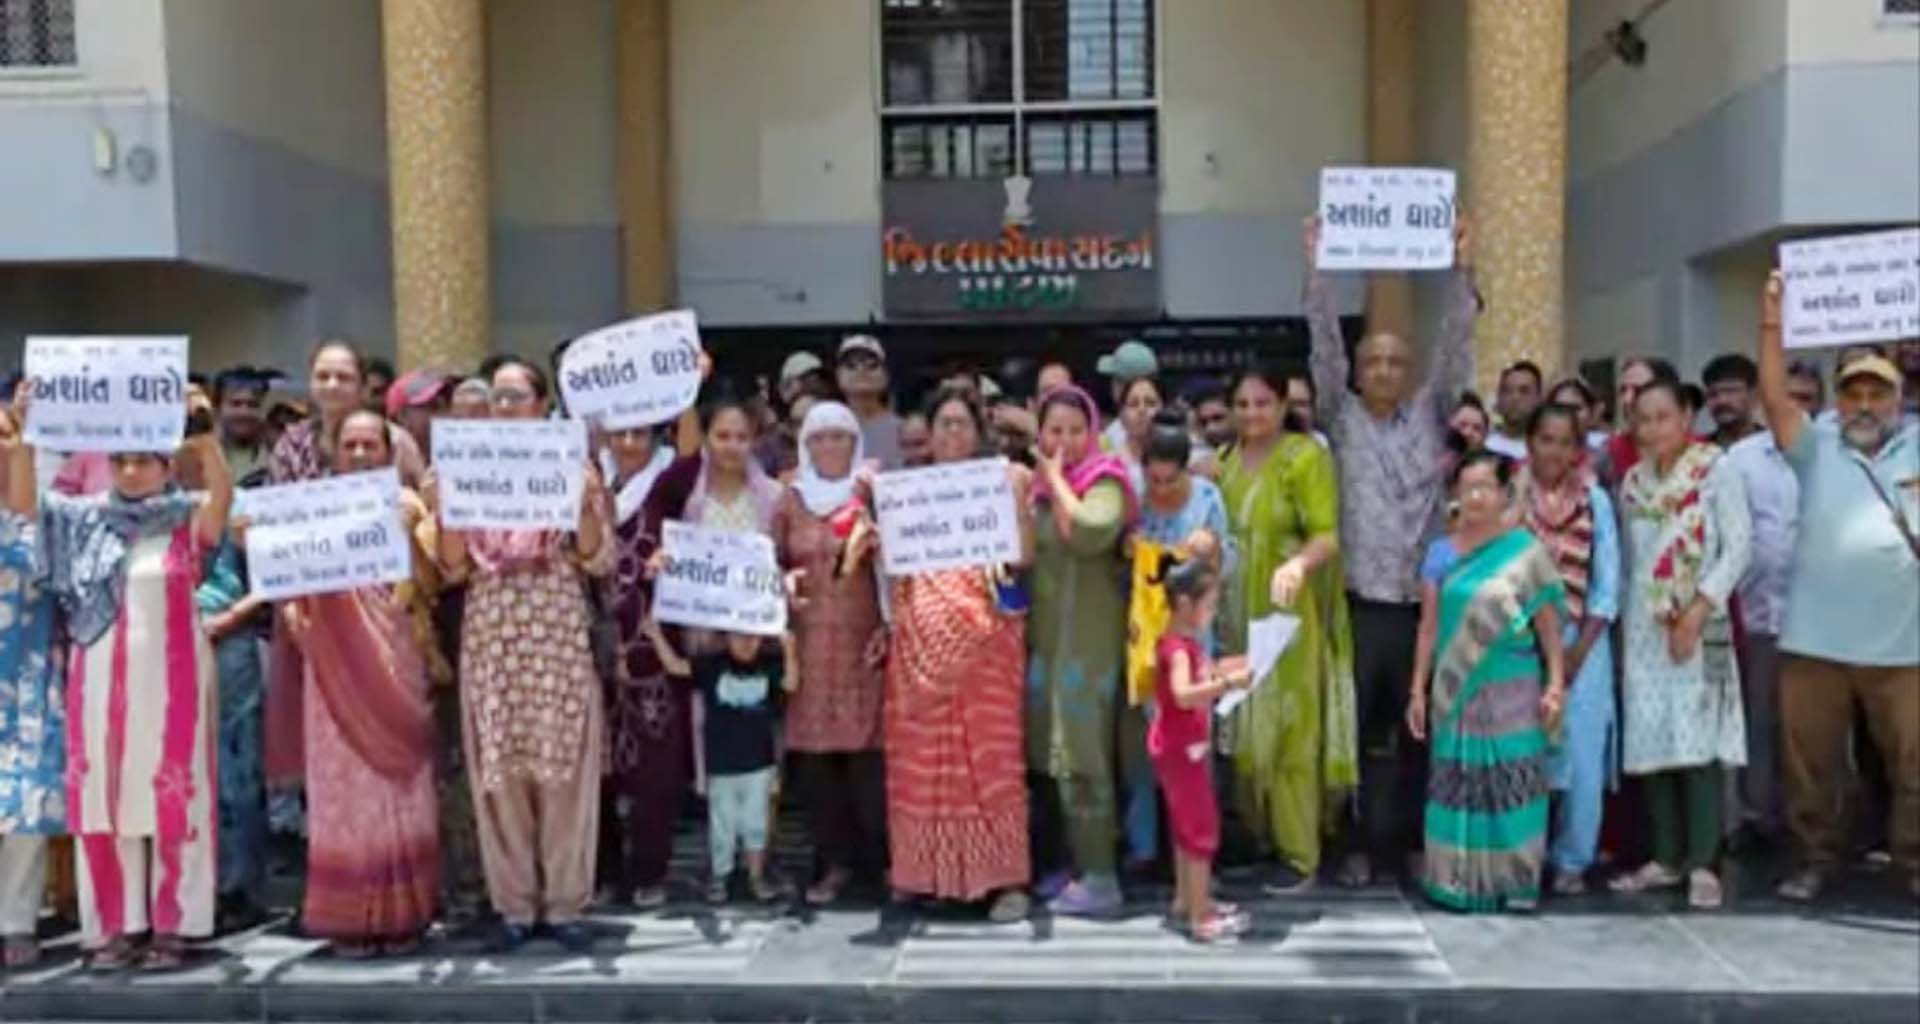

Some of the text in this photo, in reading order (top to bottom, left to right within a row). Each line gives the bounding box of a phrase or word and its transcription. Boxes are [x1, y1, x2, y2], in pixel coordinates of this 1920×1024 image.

[1326, 191, 1391, 228] અશાંત
[34, 365, 182, 405] અશાંત ધારો
[567, 350, 637, 392] અશાંત
